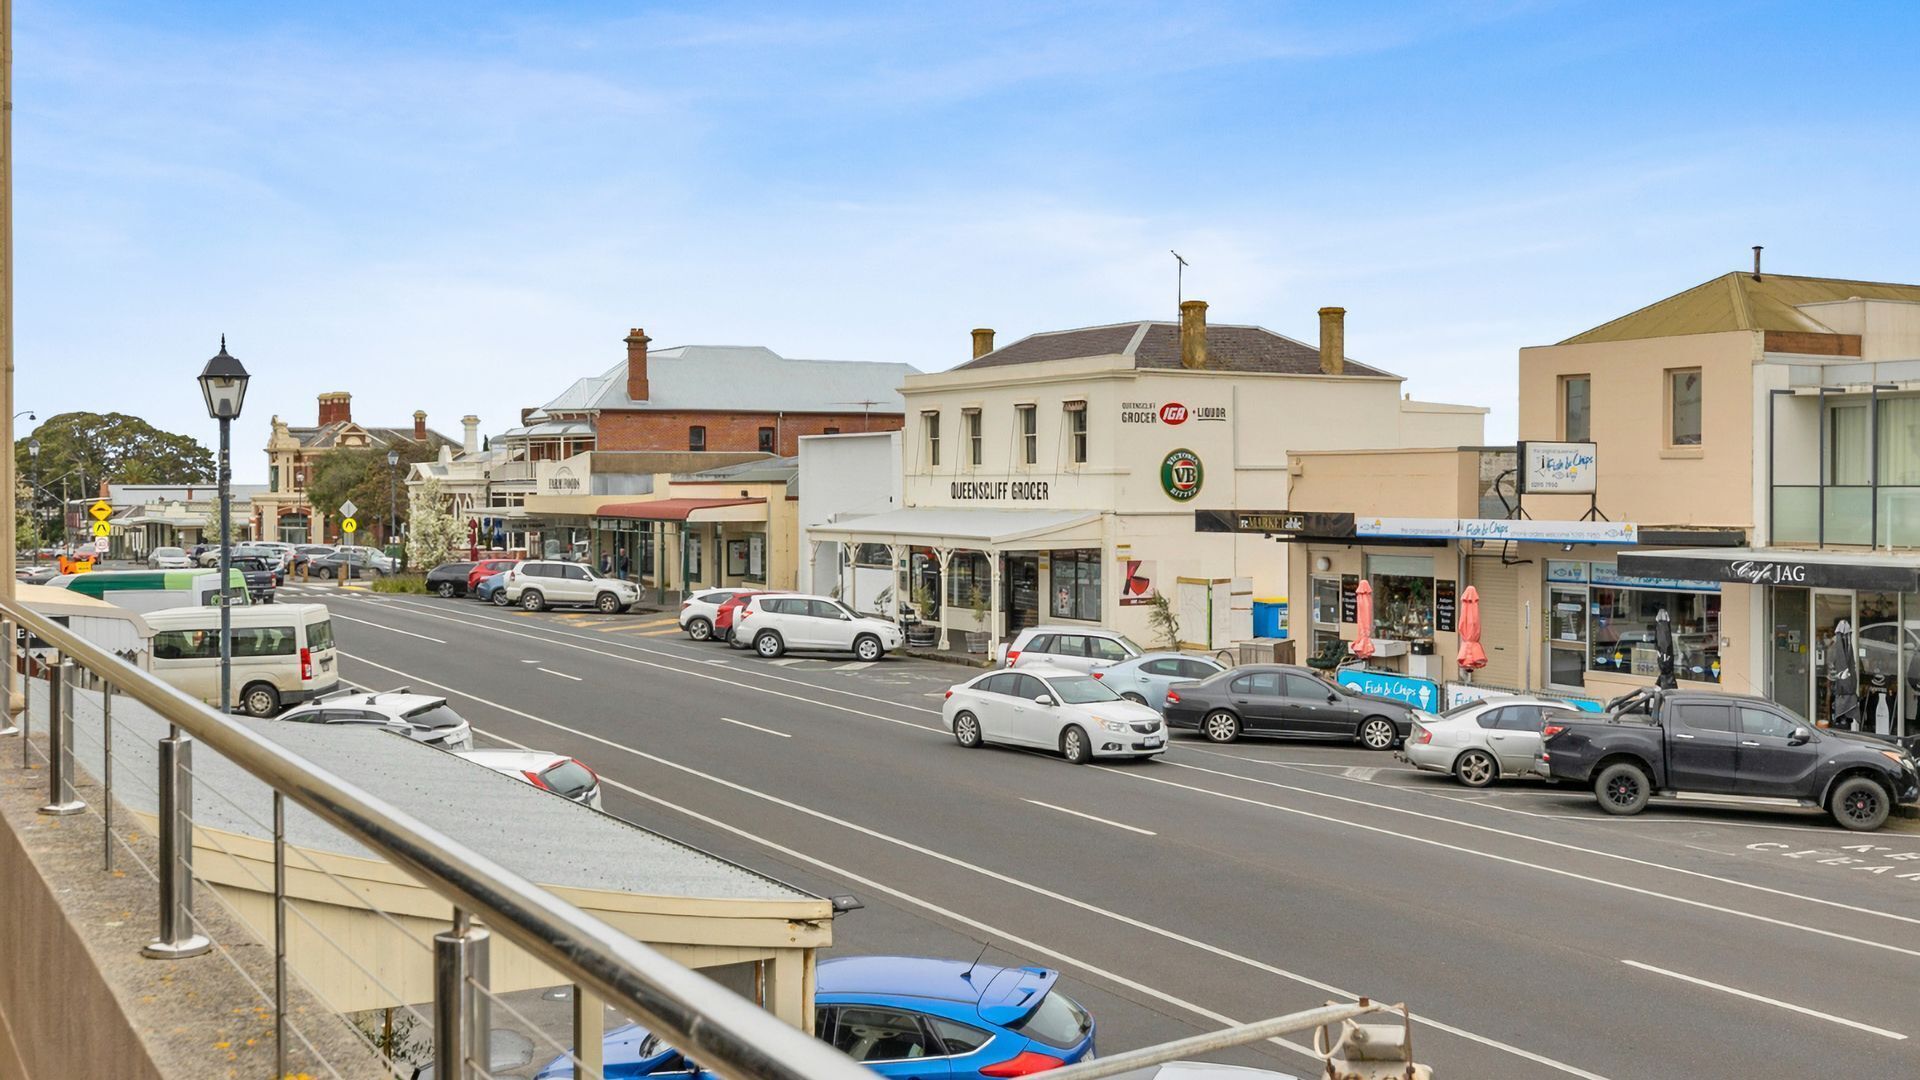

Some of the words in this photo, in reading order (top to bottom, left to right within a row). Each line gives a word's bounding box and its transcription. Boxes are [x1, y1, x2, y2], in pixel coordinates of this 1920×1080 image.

[1121, 411, 1157, 423] GROCER
[1162, 406, 1186, 420] IGA
[1197, 408, 1226, 418] LIQUOR
[1174, 467, 1196, 483] VB
[950, 482, 1008, 500] QUEENSCLIFF
[1011, 482, 1049, 500] GROCER
[1773, 565, 1805, 583] JAG
[1365, 680, 1382, 694] Fish
[1393, 682, 1416, 703] Chips
